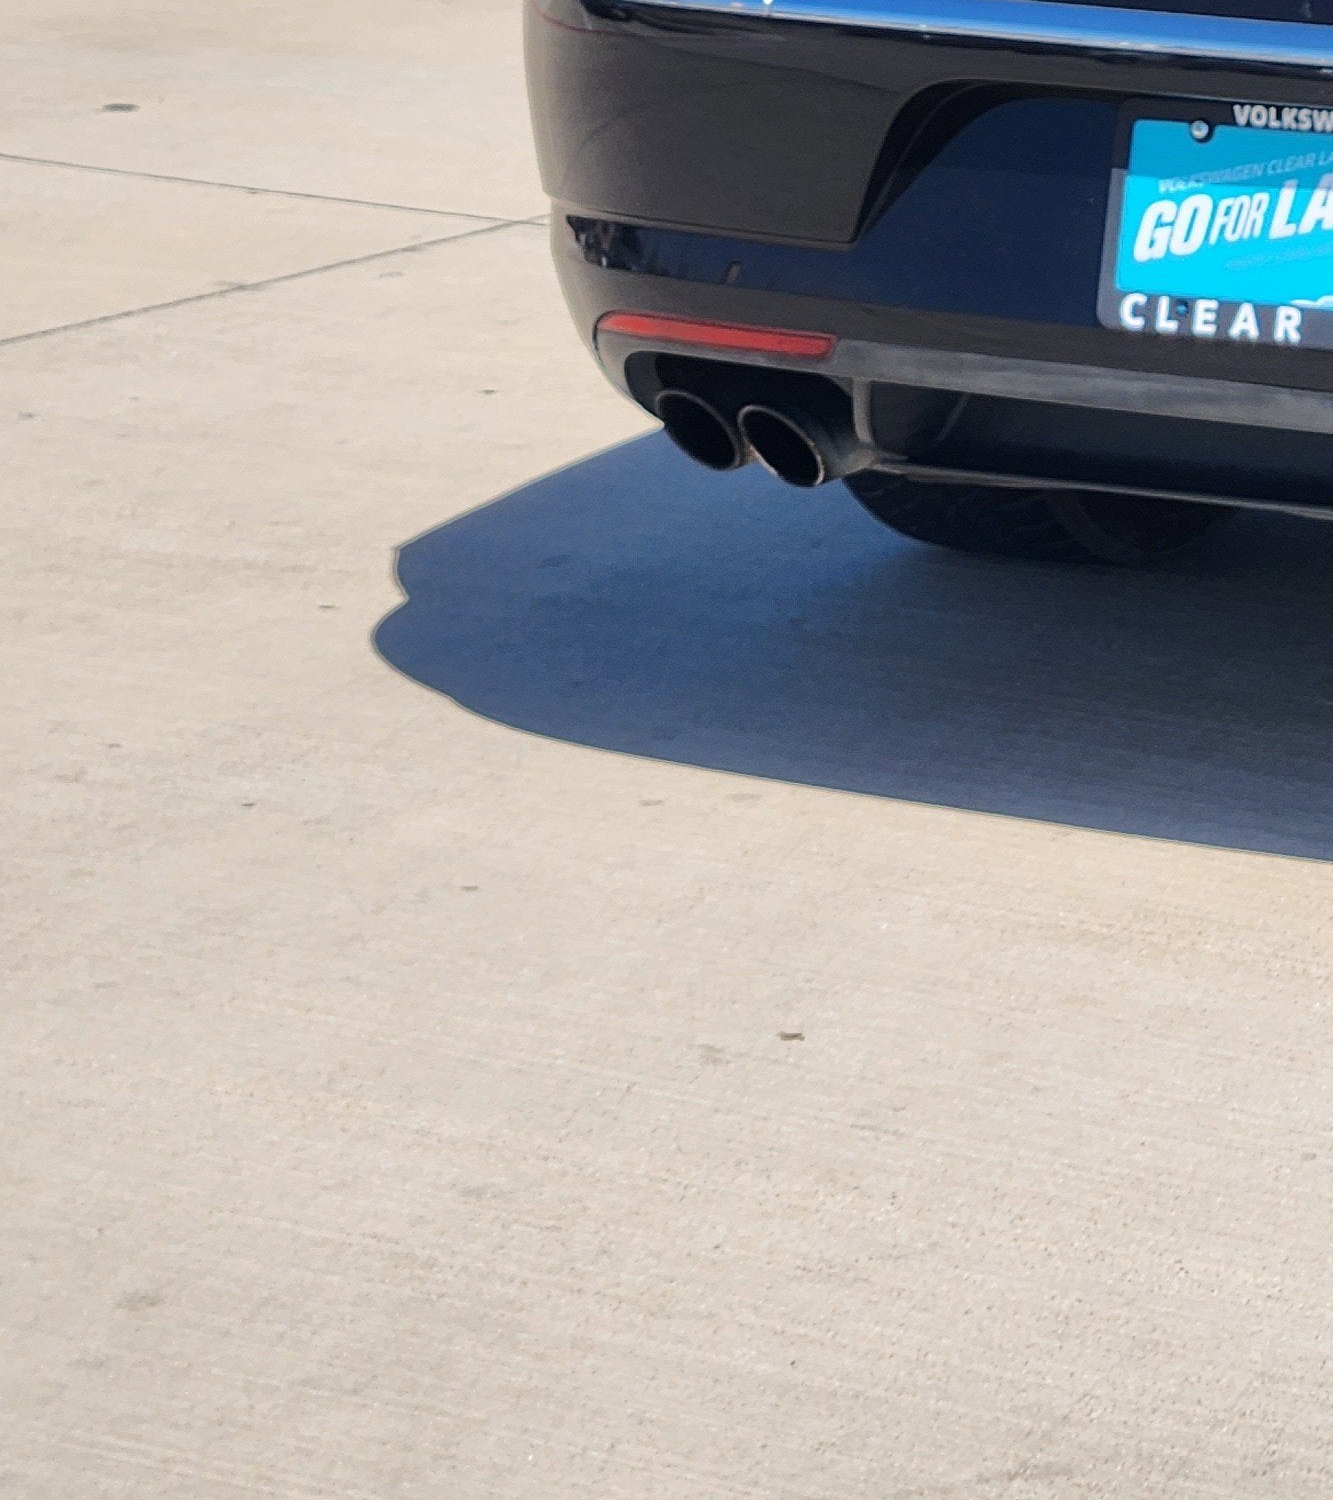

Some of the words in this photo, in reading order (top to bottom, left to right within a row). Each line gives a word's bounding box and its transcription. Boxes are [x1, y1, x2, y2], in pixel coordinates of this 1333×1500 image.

[1266, 152, 1317, 176] CLEAR
[1133, 194, 1213, 262] GO
[1208, 191, 1270, 247] FOR
[1119, 292, 1302, 343] CLEAR
